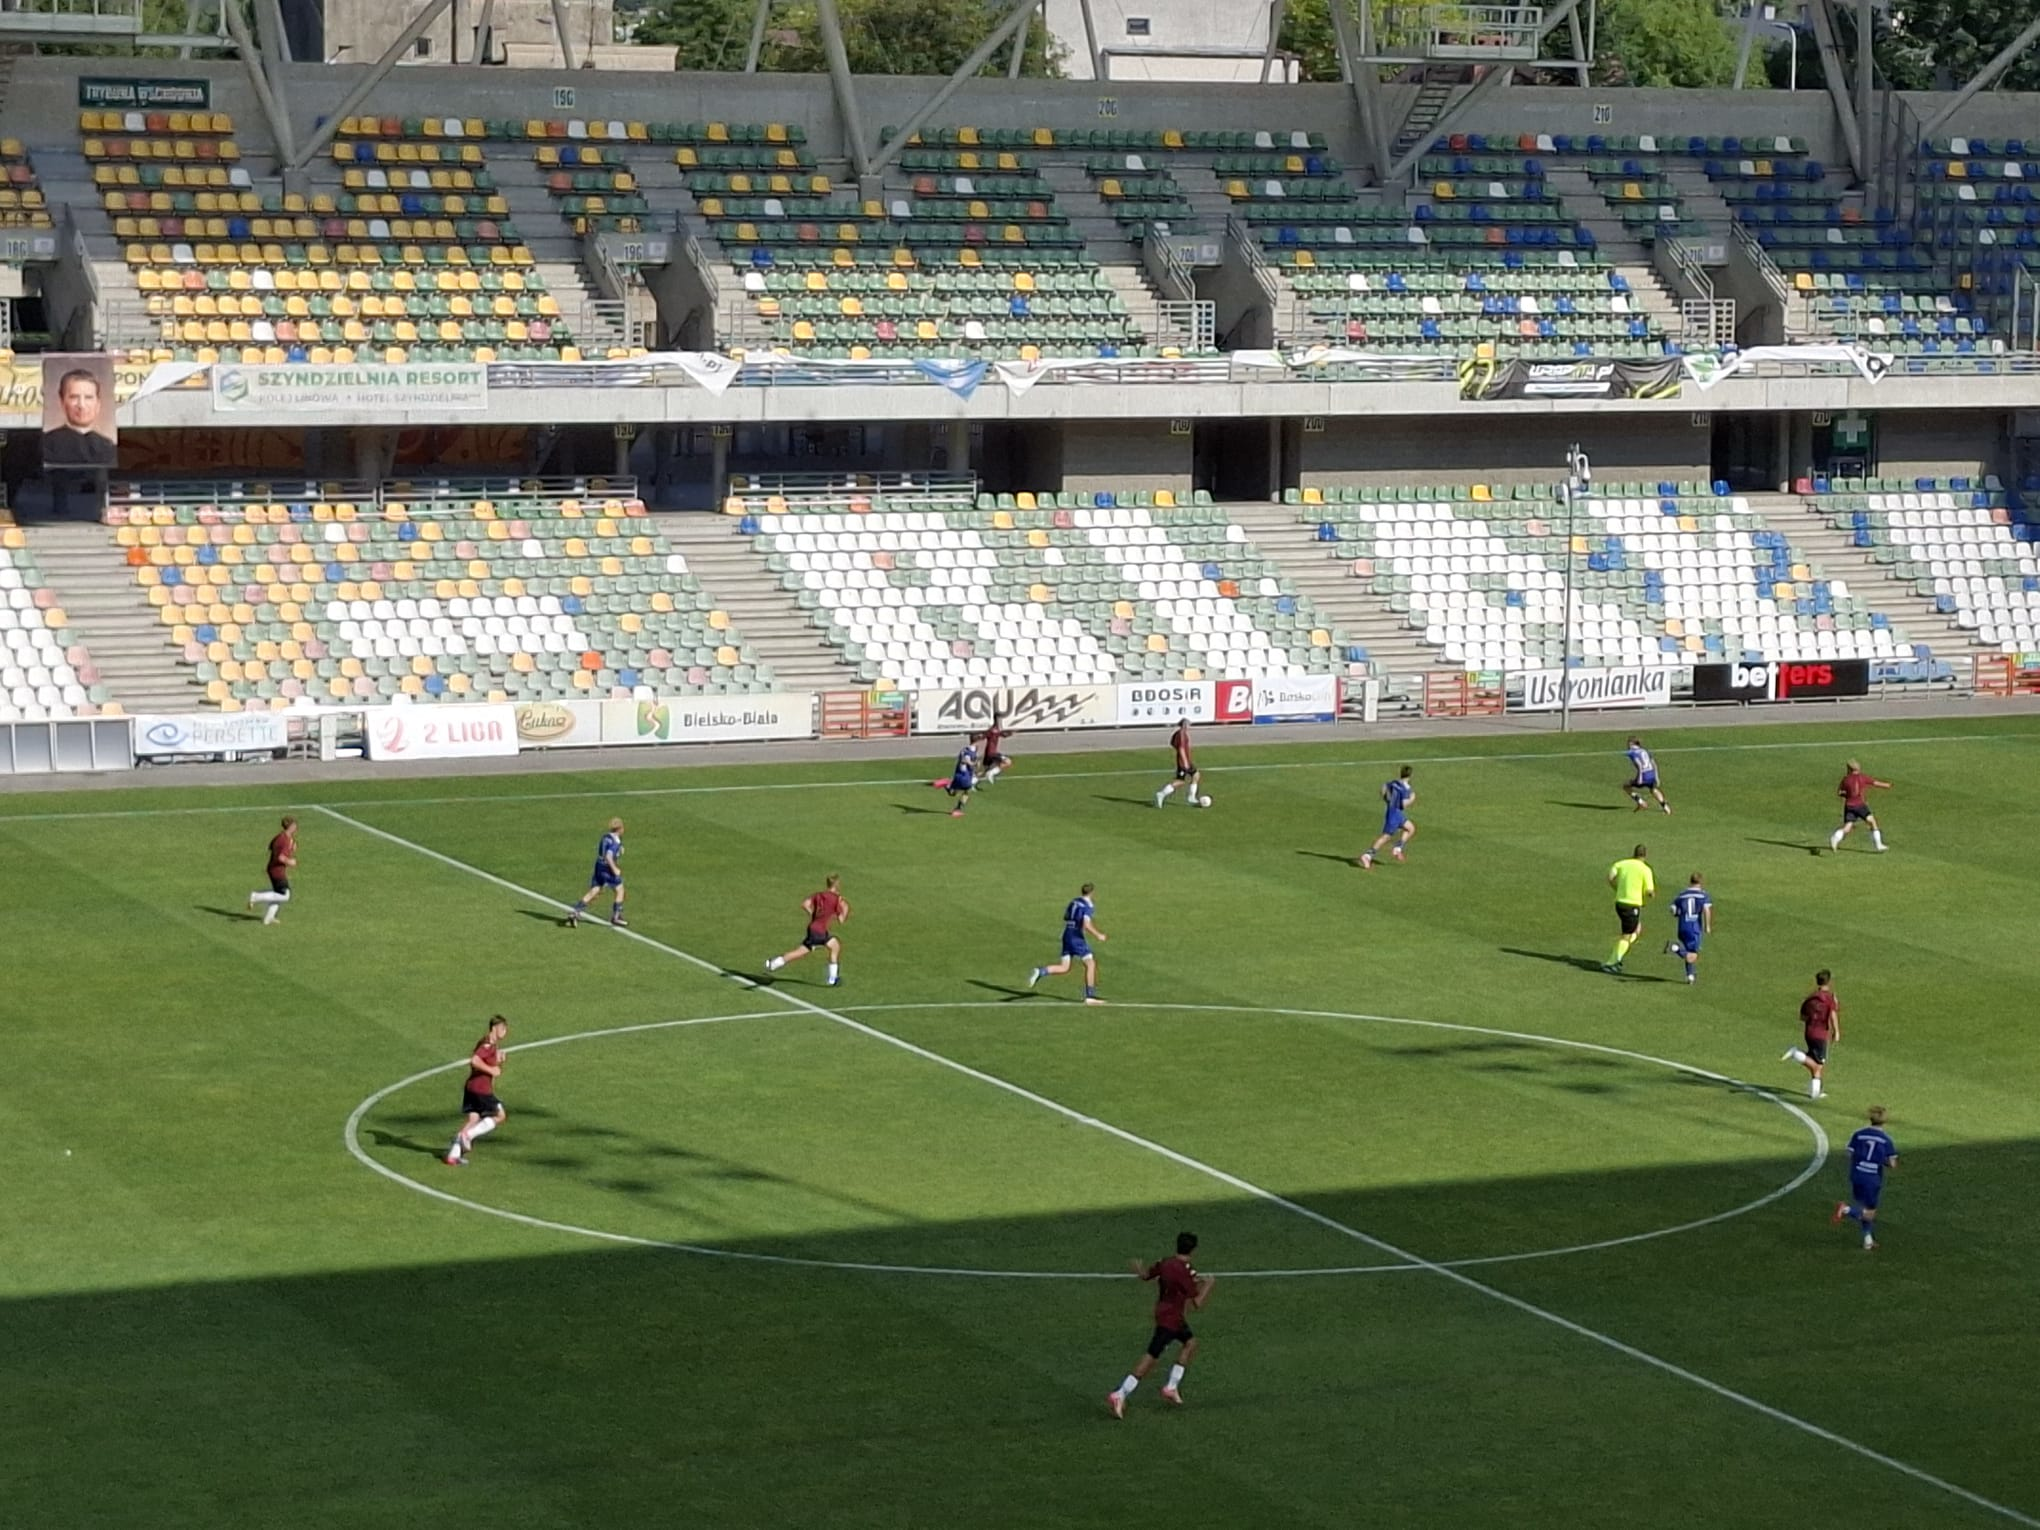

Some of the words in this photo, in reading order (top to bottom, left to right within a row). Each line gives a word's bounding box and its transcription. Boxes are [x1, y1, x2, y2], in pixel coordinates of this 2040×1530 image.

[258, 371, 400, 388] SZYNDZIELNIA
[405, 370, 482, 387] RESORT
[1530, 670, 1665, 705] Ustronianka
[938, 687, 1041, 720] AQUA
[1866, 1140, 1876, 1161] 7
